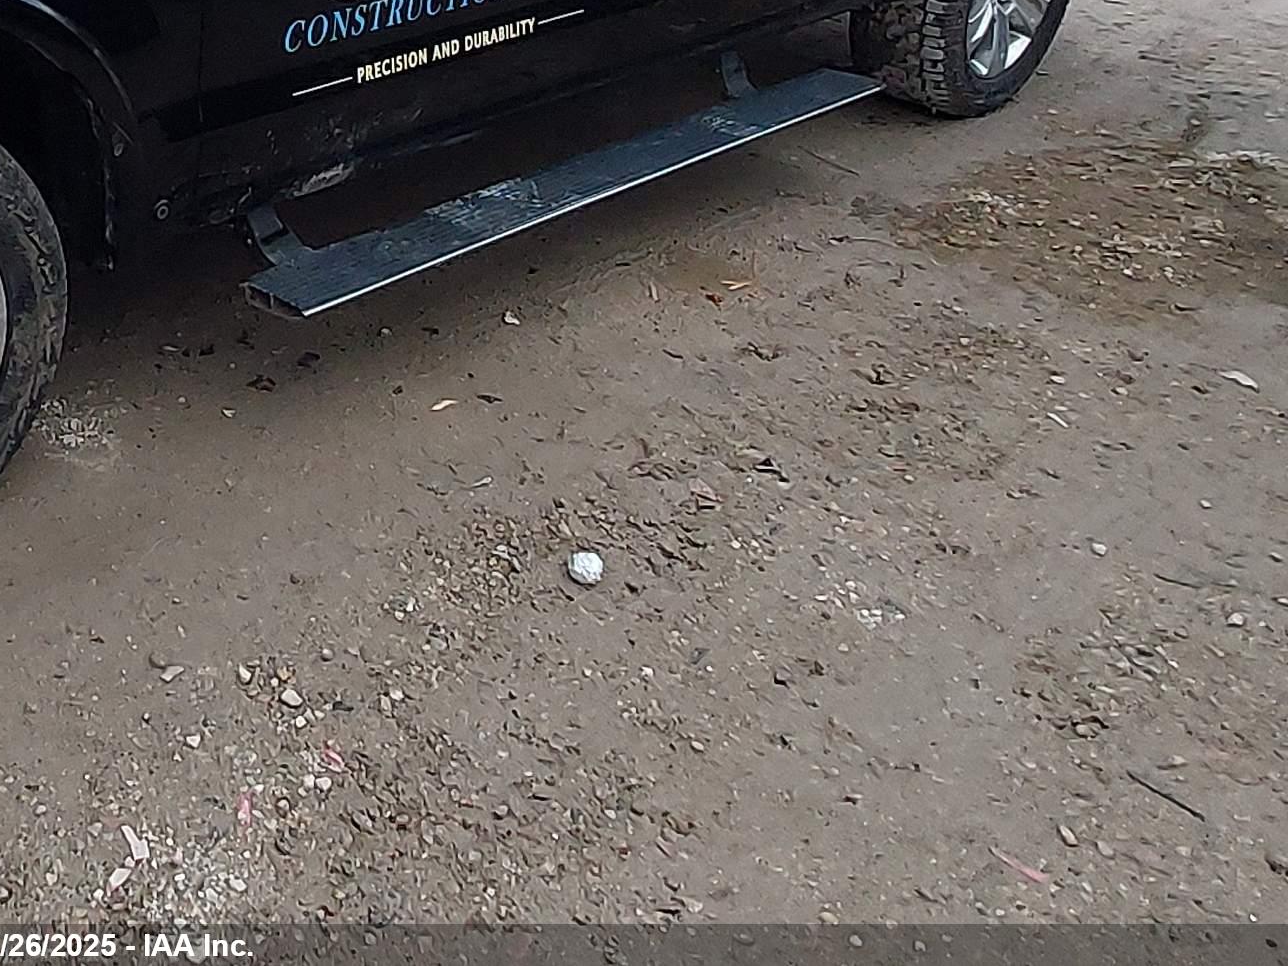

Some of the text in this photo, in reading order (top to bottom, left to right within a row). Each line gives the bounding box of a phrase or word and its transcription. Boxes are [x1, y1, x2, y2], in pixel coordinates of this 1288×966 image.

[356, 17, 536, 84] PRECISION AND DURABILITY
